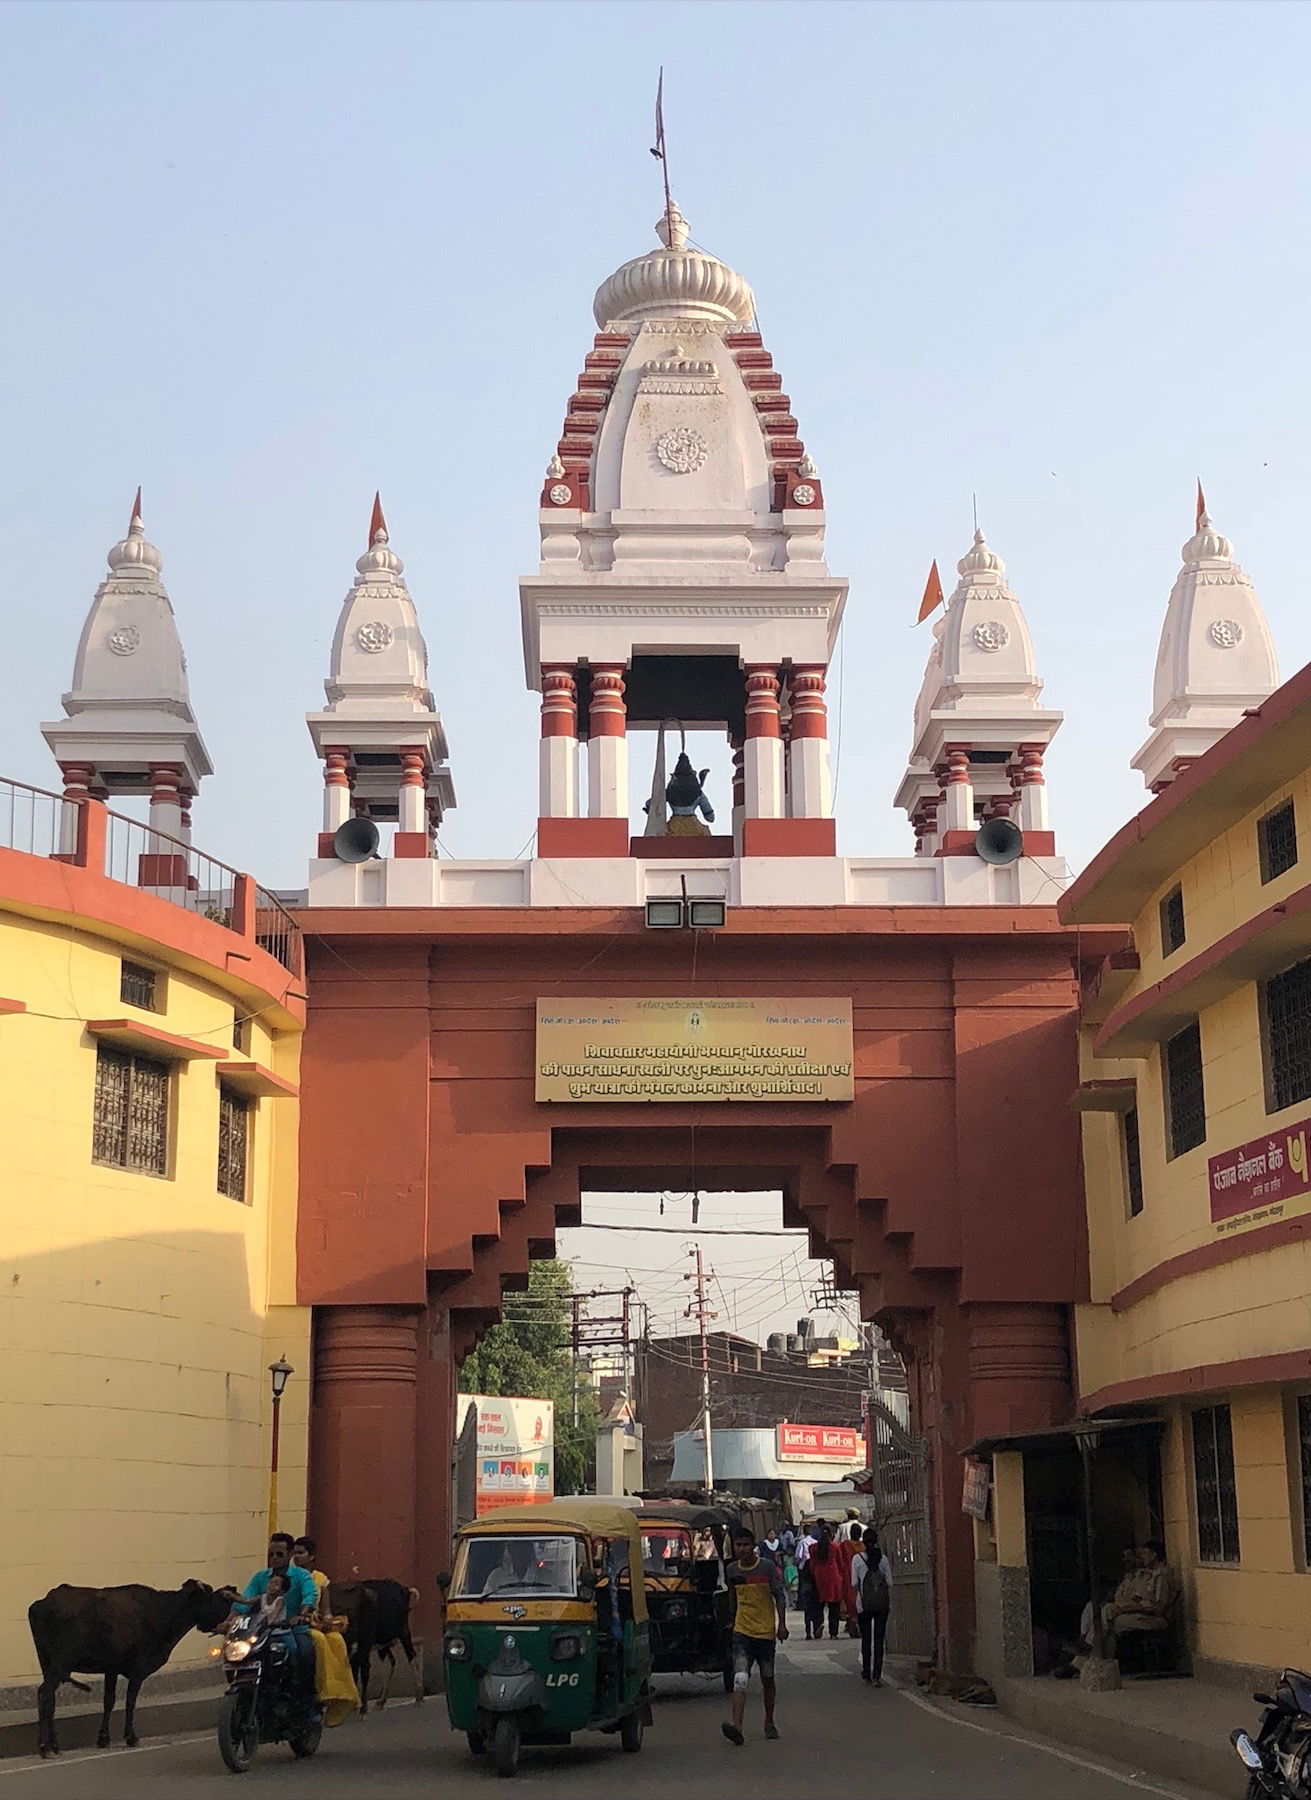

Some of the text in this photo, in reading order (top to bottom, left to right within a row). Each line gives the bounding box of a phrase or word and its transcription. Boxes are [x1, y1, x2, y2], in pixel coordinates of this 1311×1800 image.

[584, 1043, 644, 1058] शिवावतार
[645, 1043, 698, 1058] महायोगी
[541, 1062, 559, 1076] की
[561, 1064, 595, 1076] पावन
[596, 1064, 637, 1076] साधना
[638, 1062, 672, 1076] स्थली
[674, 1064, 690, 1076] पर
[766, 1062, 785, 1076] की
[787, 1062, 829, 1076] प्रतीक्षा
[831, 1062, 851, 1076] एवं
[569, 1082, 591, 1098] शुभ
[592, 1082, 622, 1094] यात्रा
[623, 1080, 641, 1094] की
[643, 1081, 679, 1094] मंगल
[680, 1082, 722, 1094] कामना
[723, 1080, 750, 1094] और
[1213, 1165, 1237, 1190] पंजाब
[1268, 1141, 1284, 1170] बैंक
[784, 1429, 855, 1449] Kurl-on Kurl-on
[545, 1673, 580, 1687] LPG
